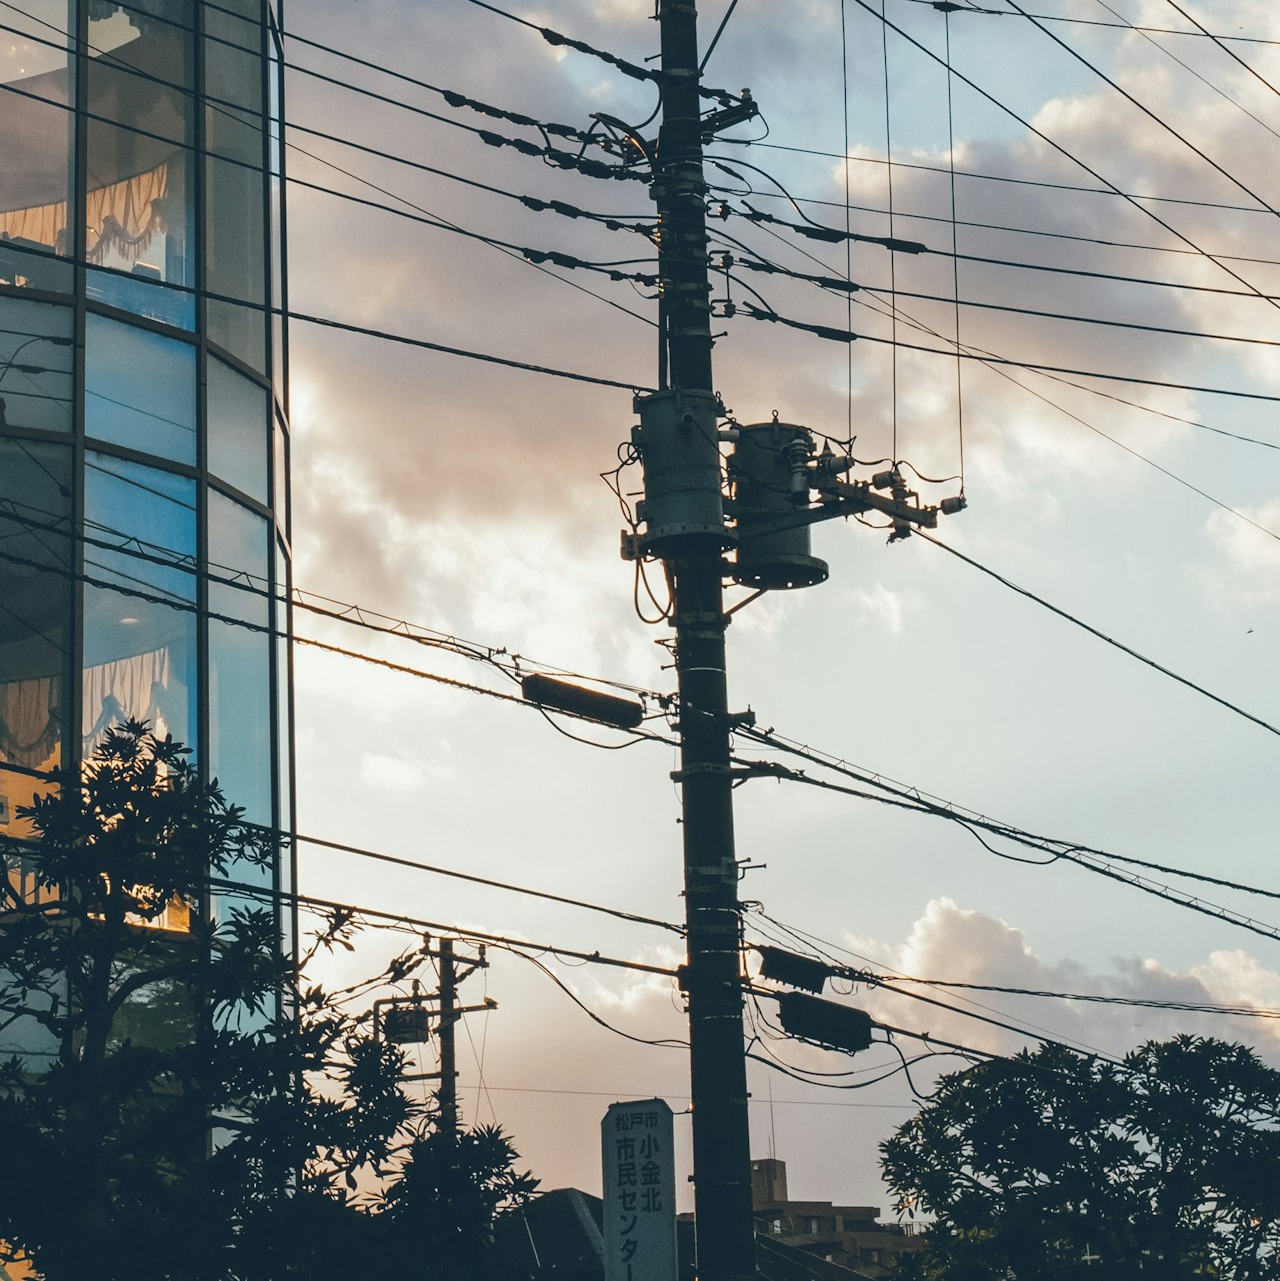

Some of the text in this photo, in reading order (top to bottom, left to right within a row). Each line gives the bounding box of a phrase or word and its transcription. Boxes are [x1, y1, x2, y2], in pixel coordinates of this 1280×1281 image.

[615, 1111, 659, 1132] 松戸市
[615, 1136, 639, 1281] 市民センター
[640, 1133, 662, 1213] 小金北
